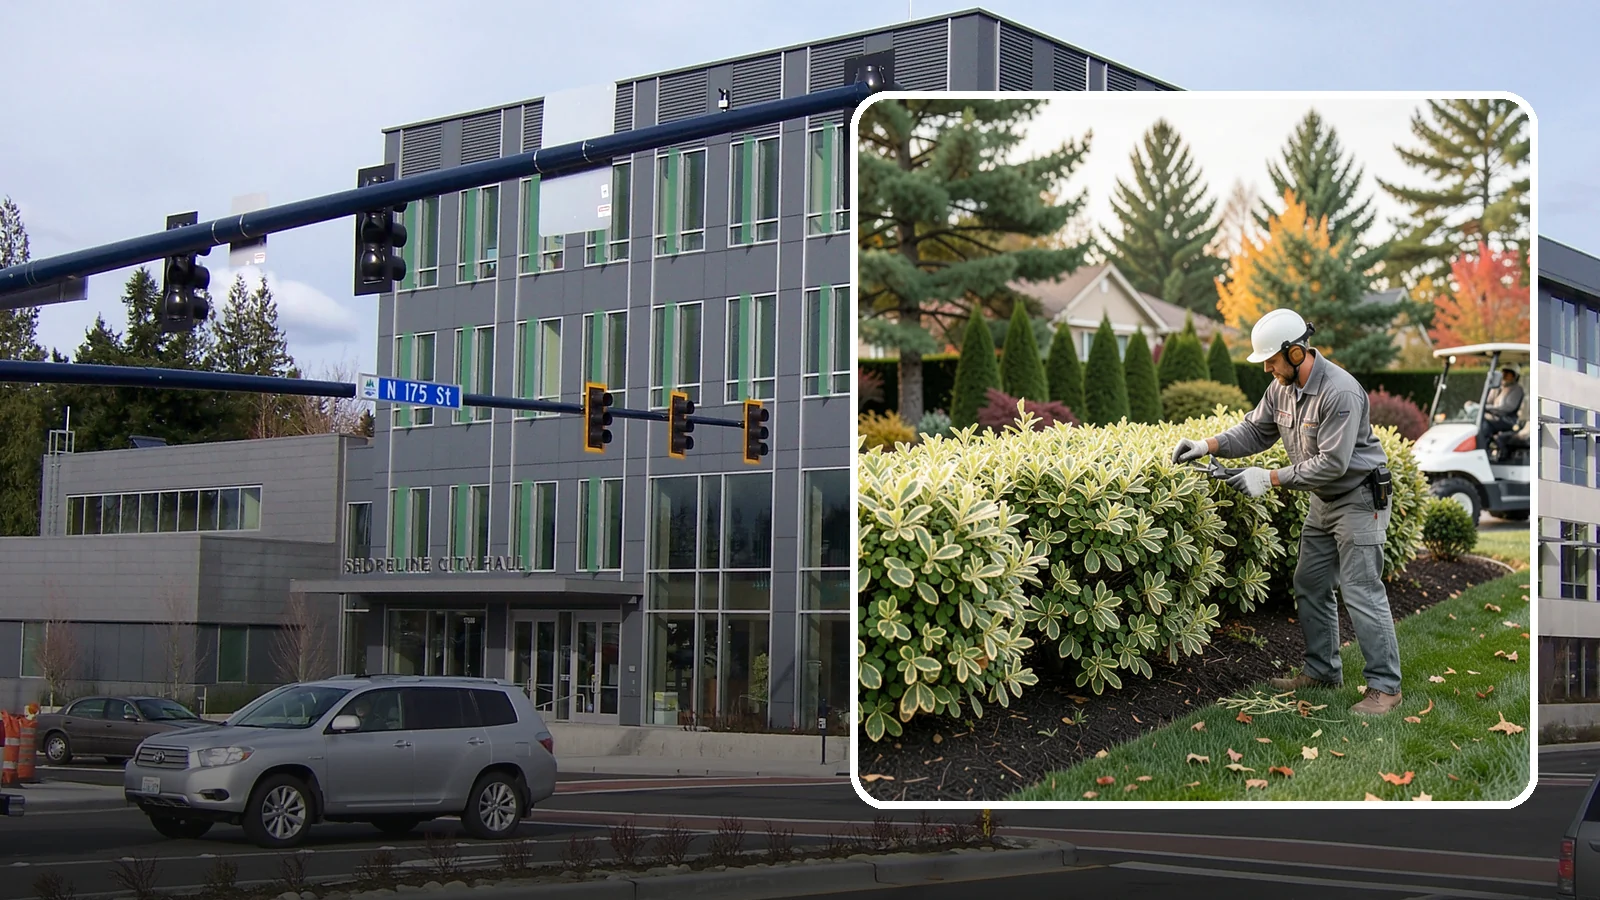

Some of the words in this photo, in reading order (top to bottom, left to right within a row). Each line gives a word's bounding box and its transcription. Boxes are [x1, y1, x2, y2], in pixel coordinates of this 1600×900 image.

[387, 380, 396, 400] N
[405, 382, 427, 403] 175
[436, 386, 451, 406] St
[343, 556, 432, 574] SHORELINE
[438, 556, 476, 572] CITY
[483, 556, 525, 571] HALL
